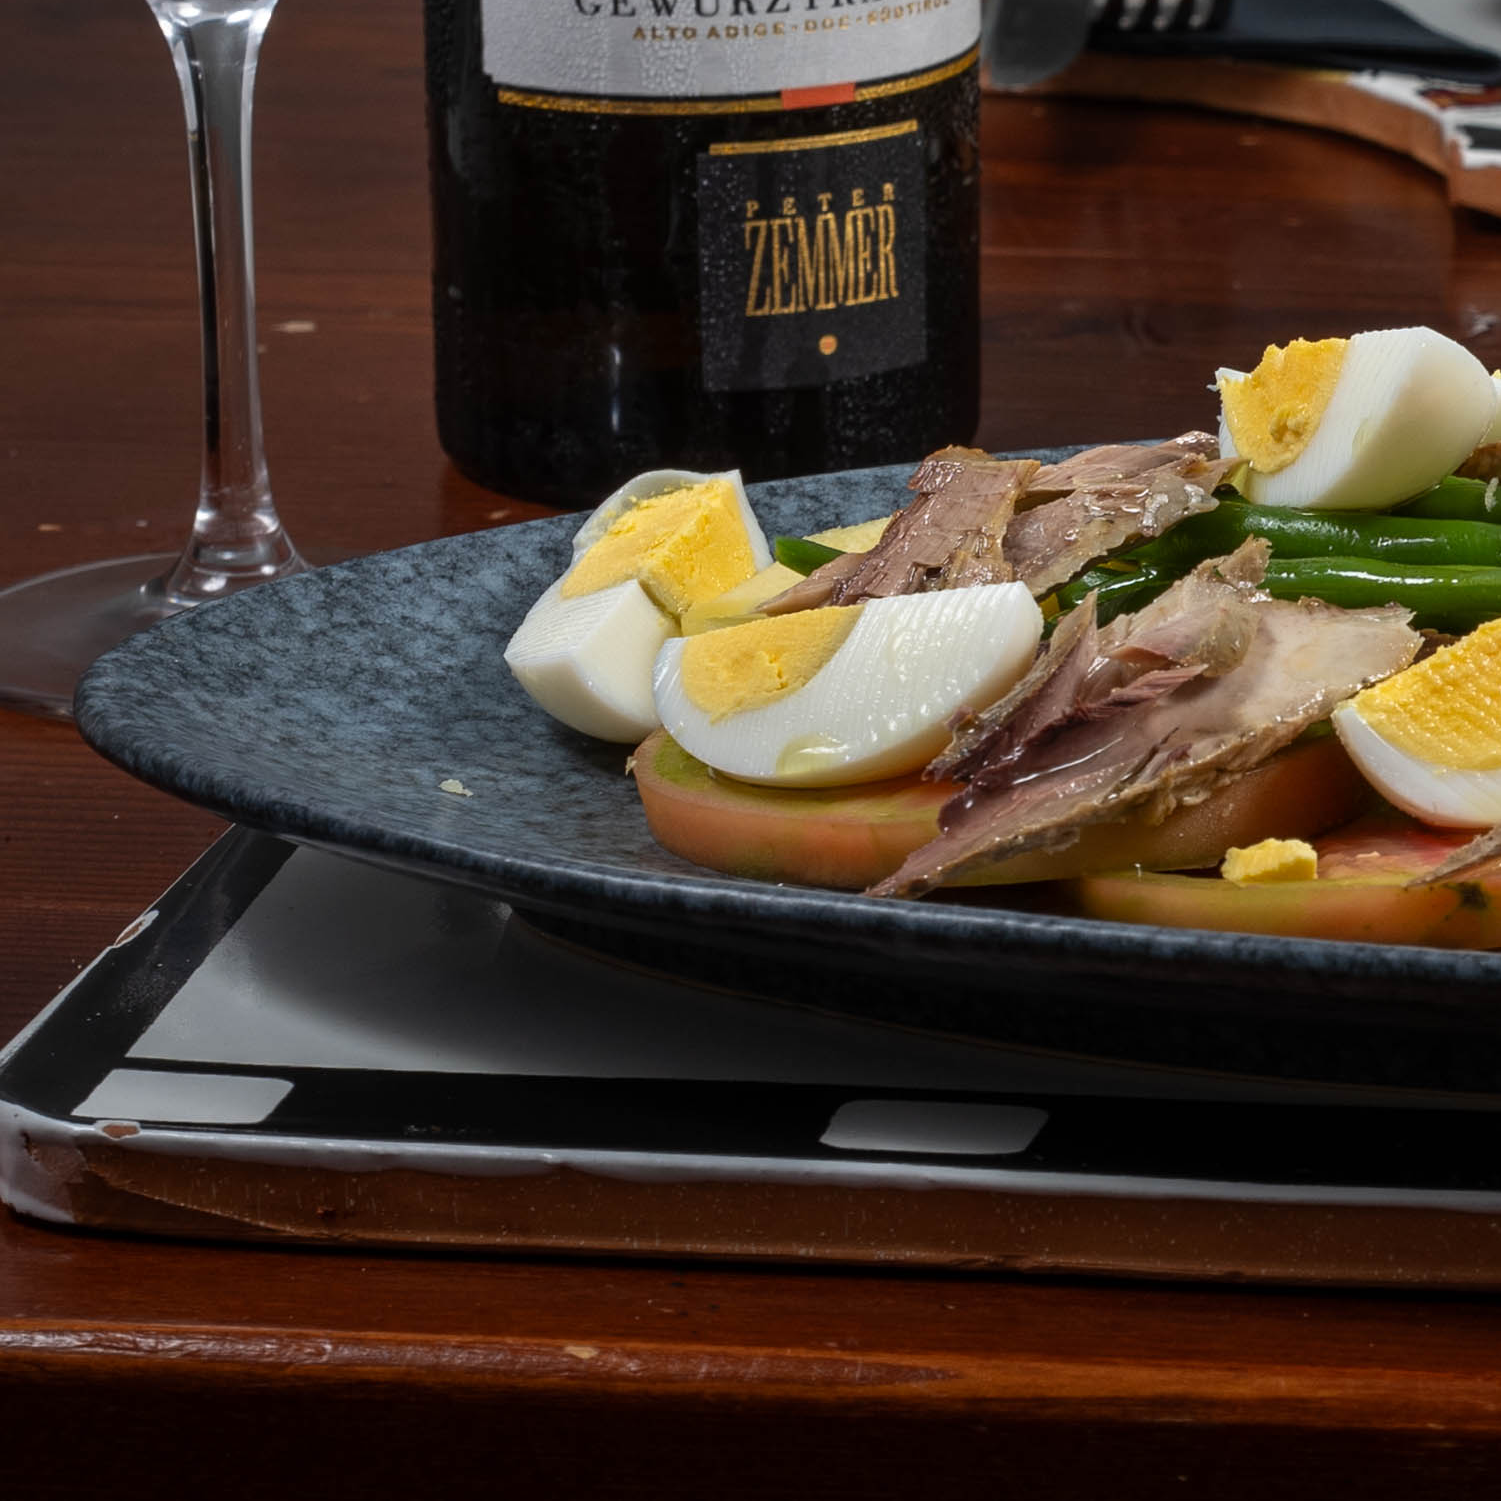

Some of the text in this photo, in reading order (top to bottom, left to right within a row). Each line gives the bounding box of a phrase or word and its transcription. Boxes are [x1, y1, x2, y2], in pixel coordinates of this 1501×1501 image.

[633, 25, 697, 41] ALTO
[706, 22, 785, 40] ADIGE
[746, 182, 895, 218] PETER
[745, 204, 899, 316] ZEMMER
